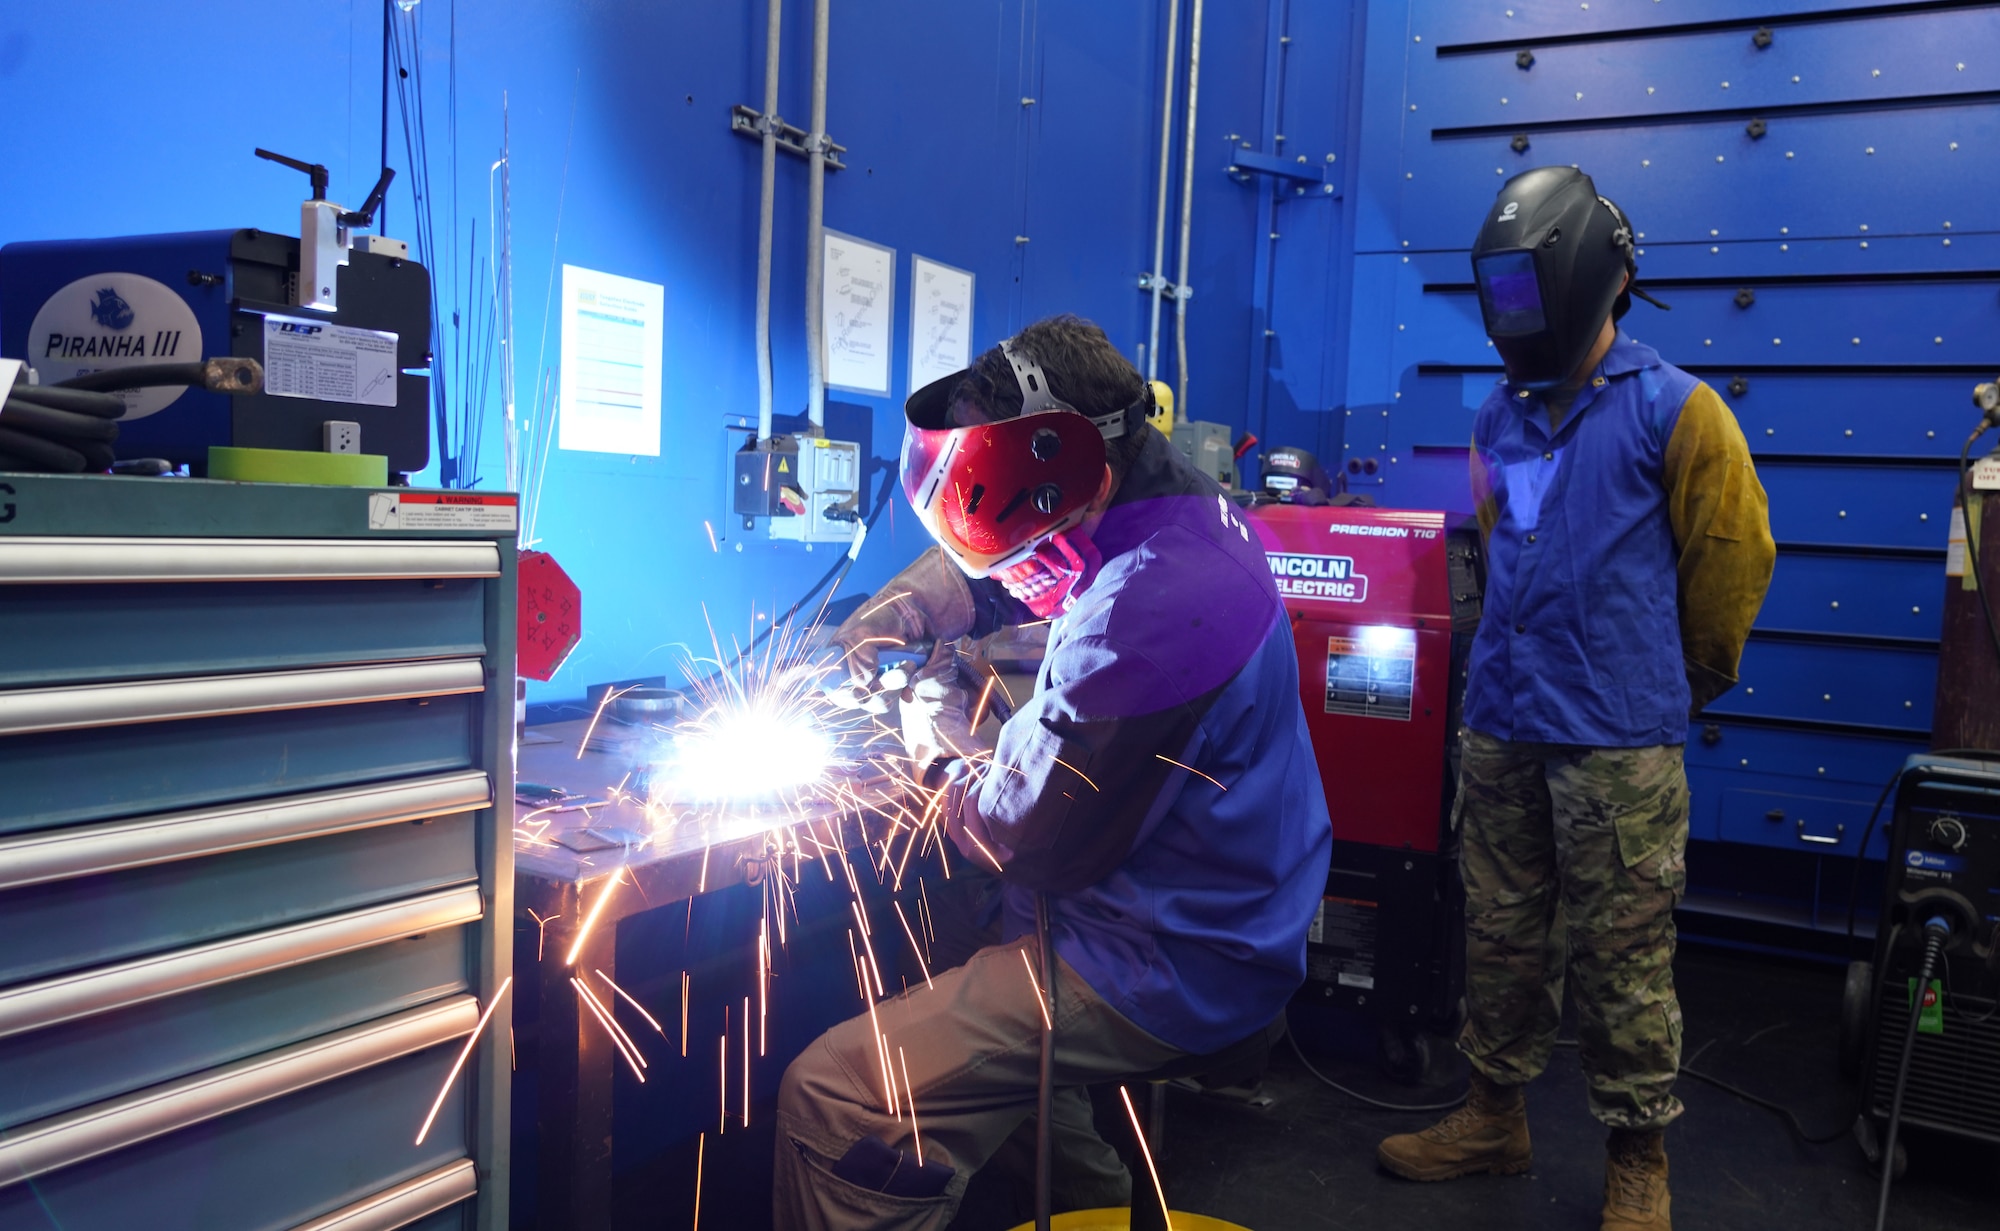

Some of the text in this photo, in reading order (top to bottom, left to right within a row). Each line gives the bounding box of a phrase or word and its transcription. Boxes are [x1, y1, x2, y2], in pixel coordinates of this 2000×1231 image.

[281, 322, 322, 335] DGP
[45, 330, 182, 358] PIRANHA III
[445, 496, 483, 505] WARNING
[1329, 523, 1438, 539] PRECISION TIG
[1266, 556, 1347, 579] NCOLN
[1275, 578, 1356, 598] ELECTRIC
[1925, 856, 1945, 865] Miller
